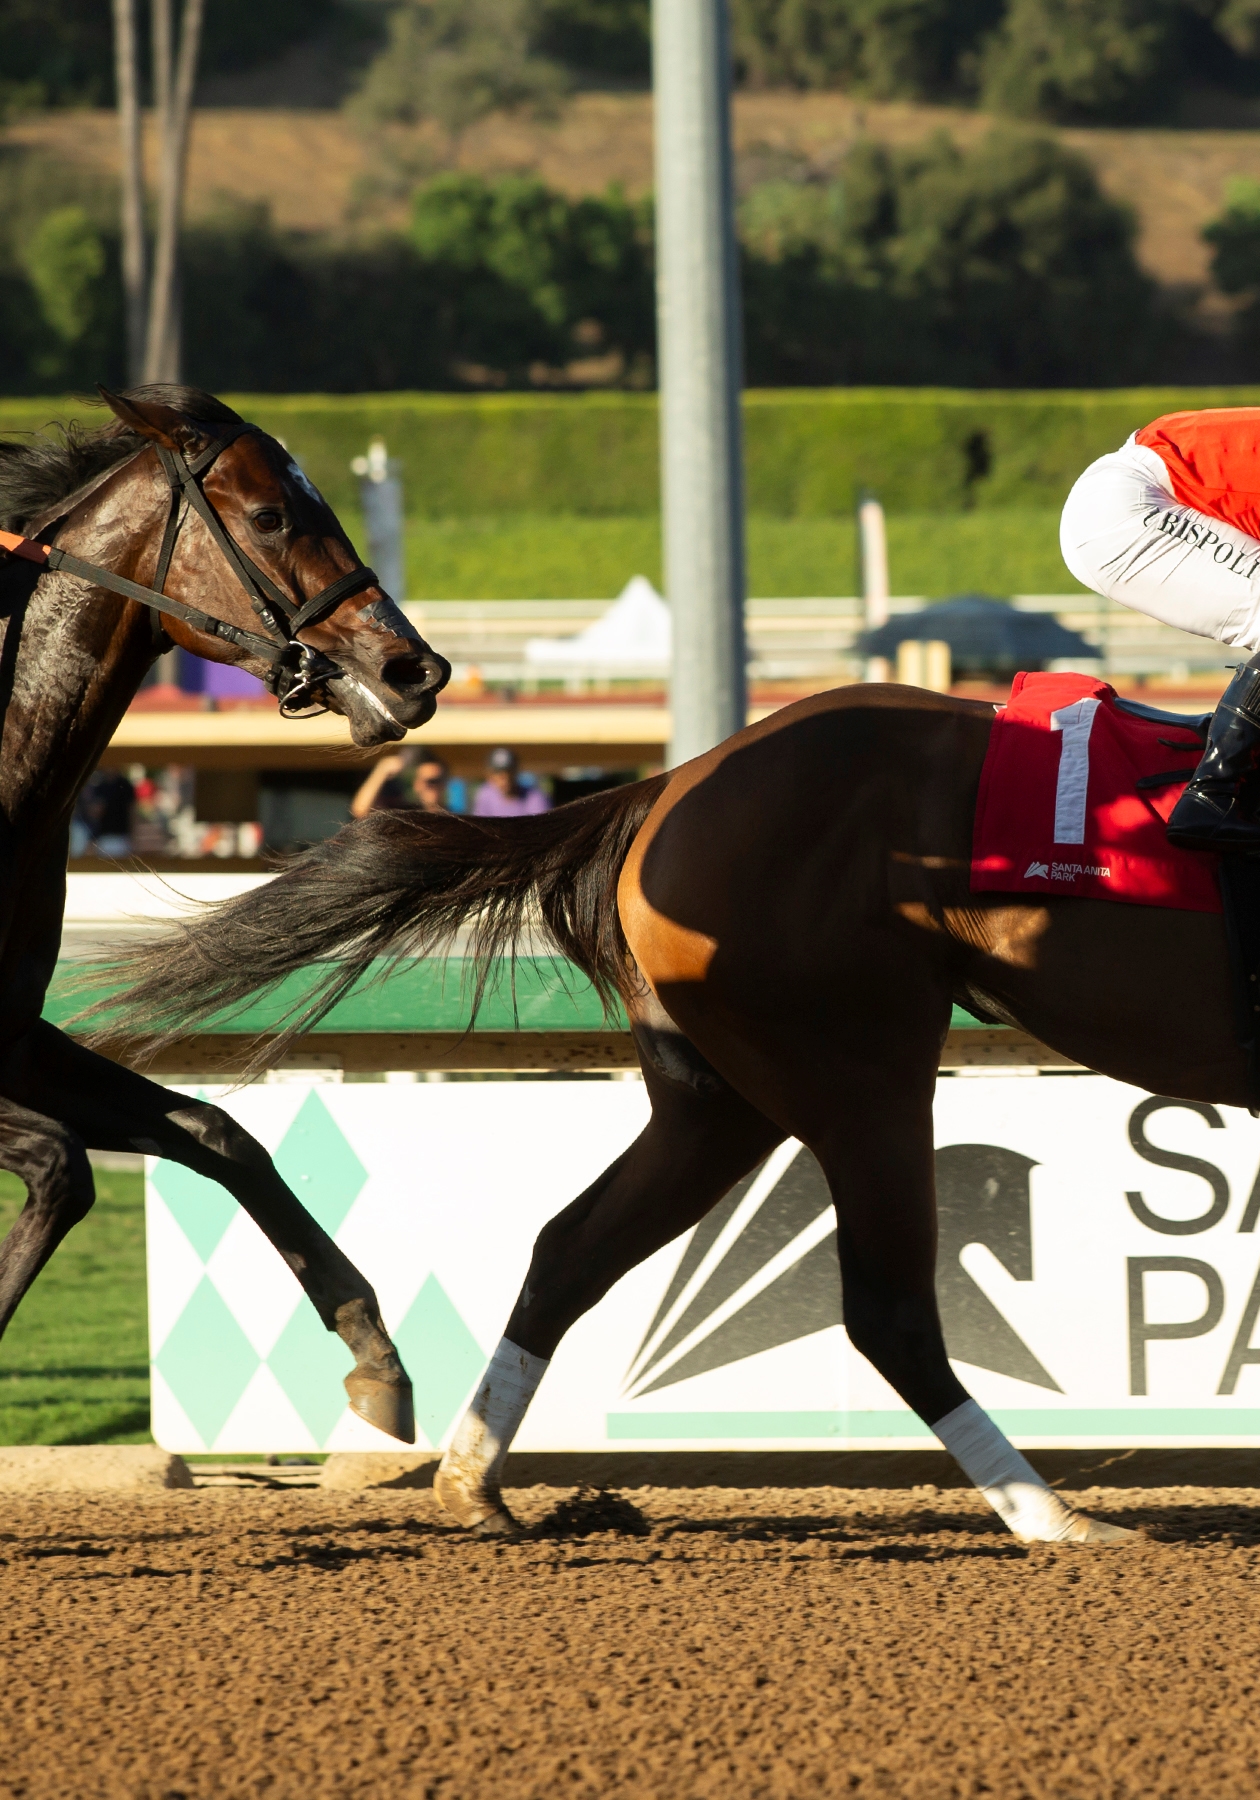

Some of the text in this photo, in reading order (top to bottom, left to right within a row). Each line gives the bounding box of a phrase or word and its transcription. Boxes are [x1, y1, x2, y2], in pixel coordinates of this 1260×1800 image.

[1050, 697, 1102, 845] 1
[1051, 862, 1111, 878] SANTA ANITA
[1051, 871, 1075, 882] PARK
